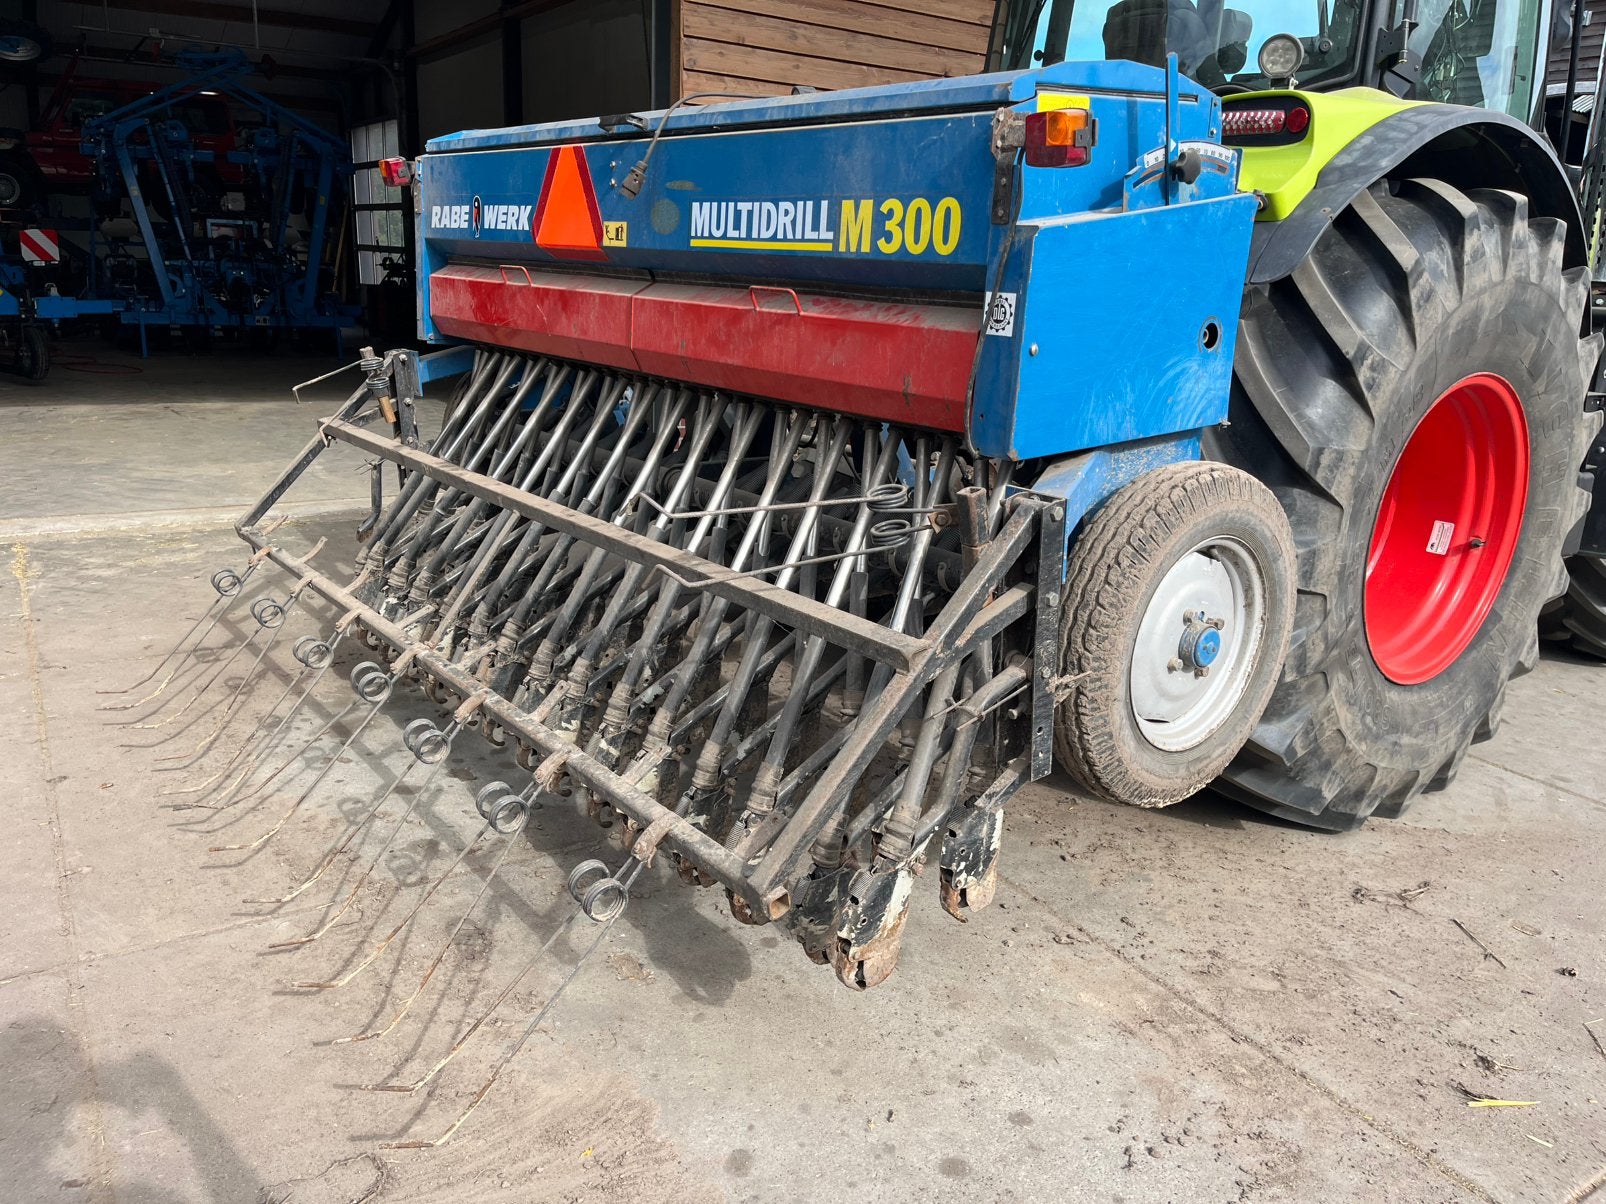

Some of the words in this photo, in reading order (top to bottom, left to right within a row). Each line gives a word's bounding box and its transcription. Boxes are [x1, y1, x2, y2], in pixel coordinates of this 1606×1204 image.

[431, 204, 470, 229] RABE
[483, 204, 533, 231] WERK
[690, 200, 834, 240] MULTIDRILL
[838, 199, 874, 253] M
[876, 196, 962, 256] 300
